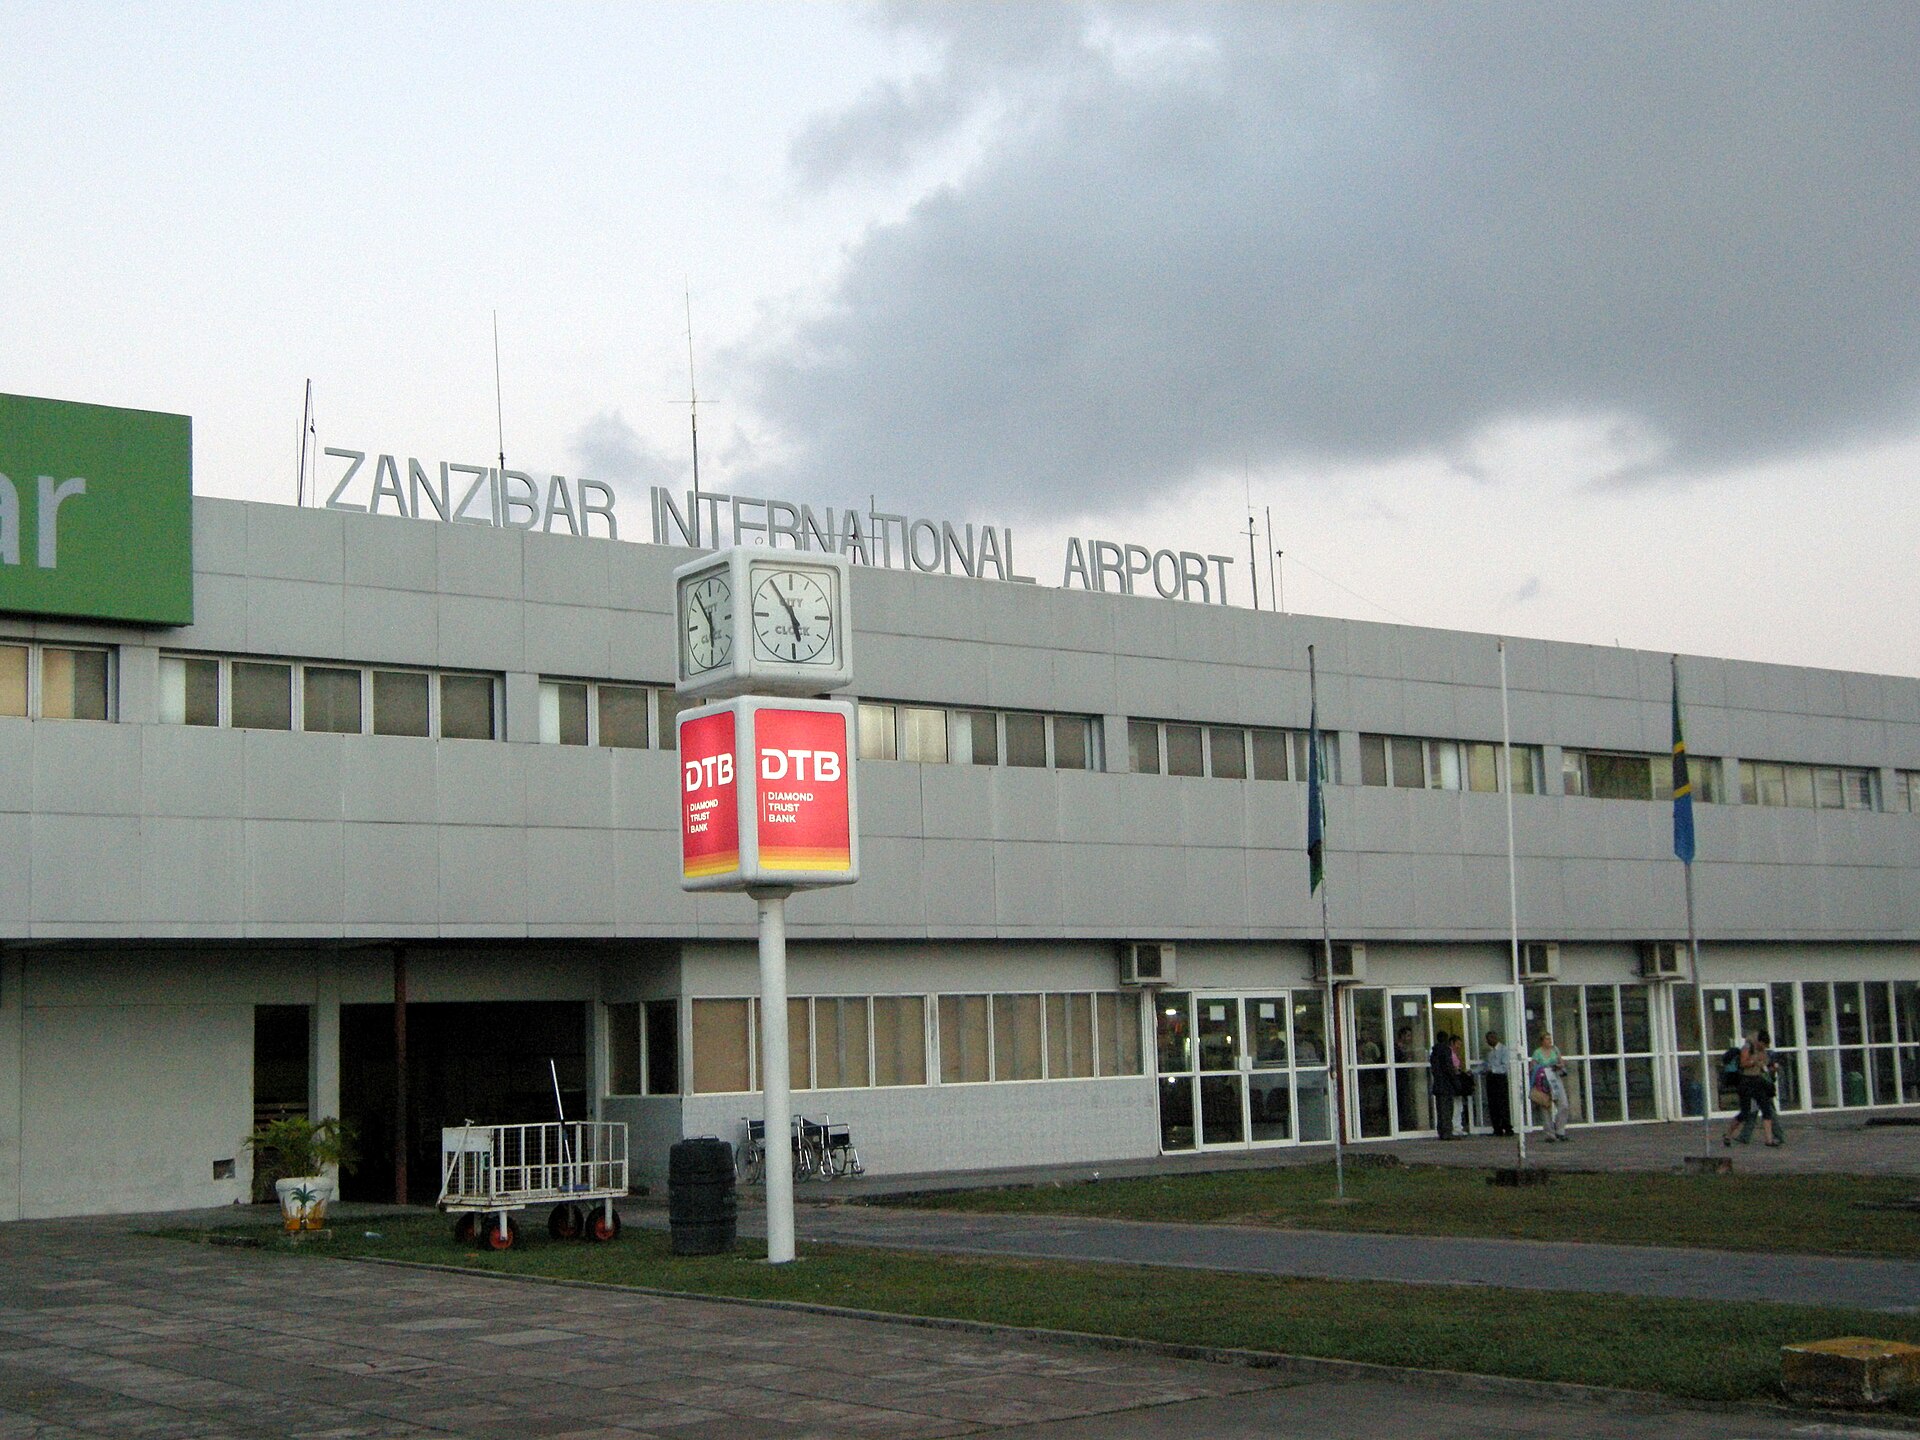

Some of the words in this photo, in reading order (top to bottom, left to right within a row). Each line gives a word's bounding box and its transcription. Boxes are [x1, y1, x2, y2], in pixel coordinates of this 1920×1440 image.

[324, 447, 617, 540] ZANZIBAR
[650, 486, 1036, 585] INTERNATIONAL
[1063, 536, 1234, 606] AIRPORT
[701, 629, 722, 645] CLCK
[761, 748, 841, 782] DTB
[686, 752, 734, 792] DTB
[768, 791, 814, 802] DIAMOND
[690, 798, 719, 811] DIAMOND
[768, 802, 800, 813] TRUST
[690, 811, 710, 822] TRUST
[768, 814, 797, 824] BANK
[690, 822, 708, 834] BANK
